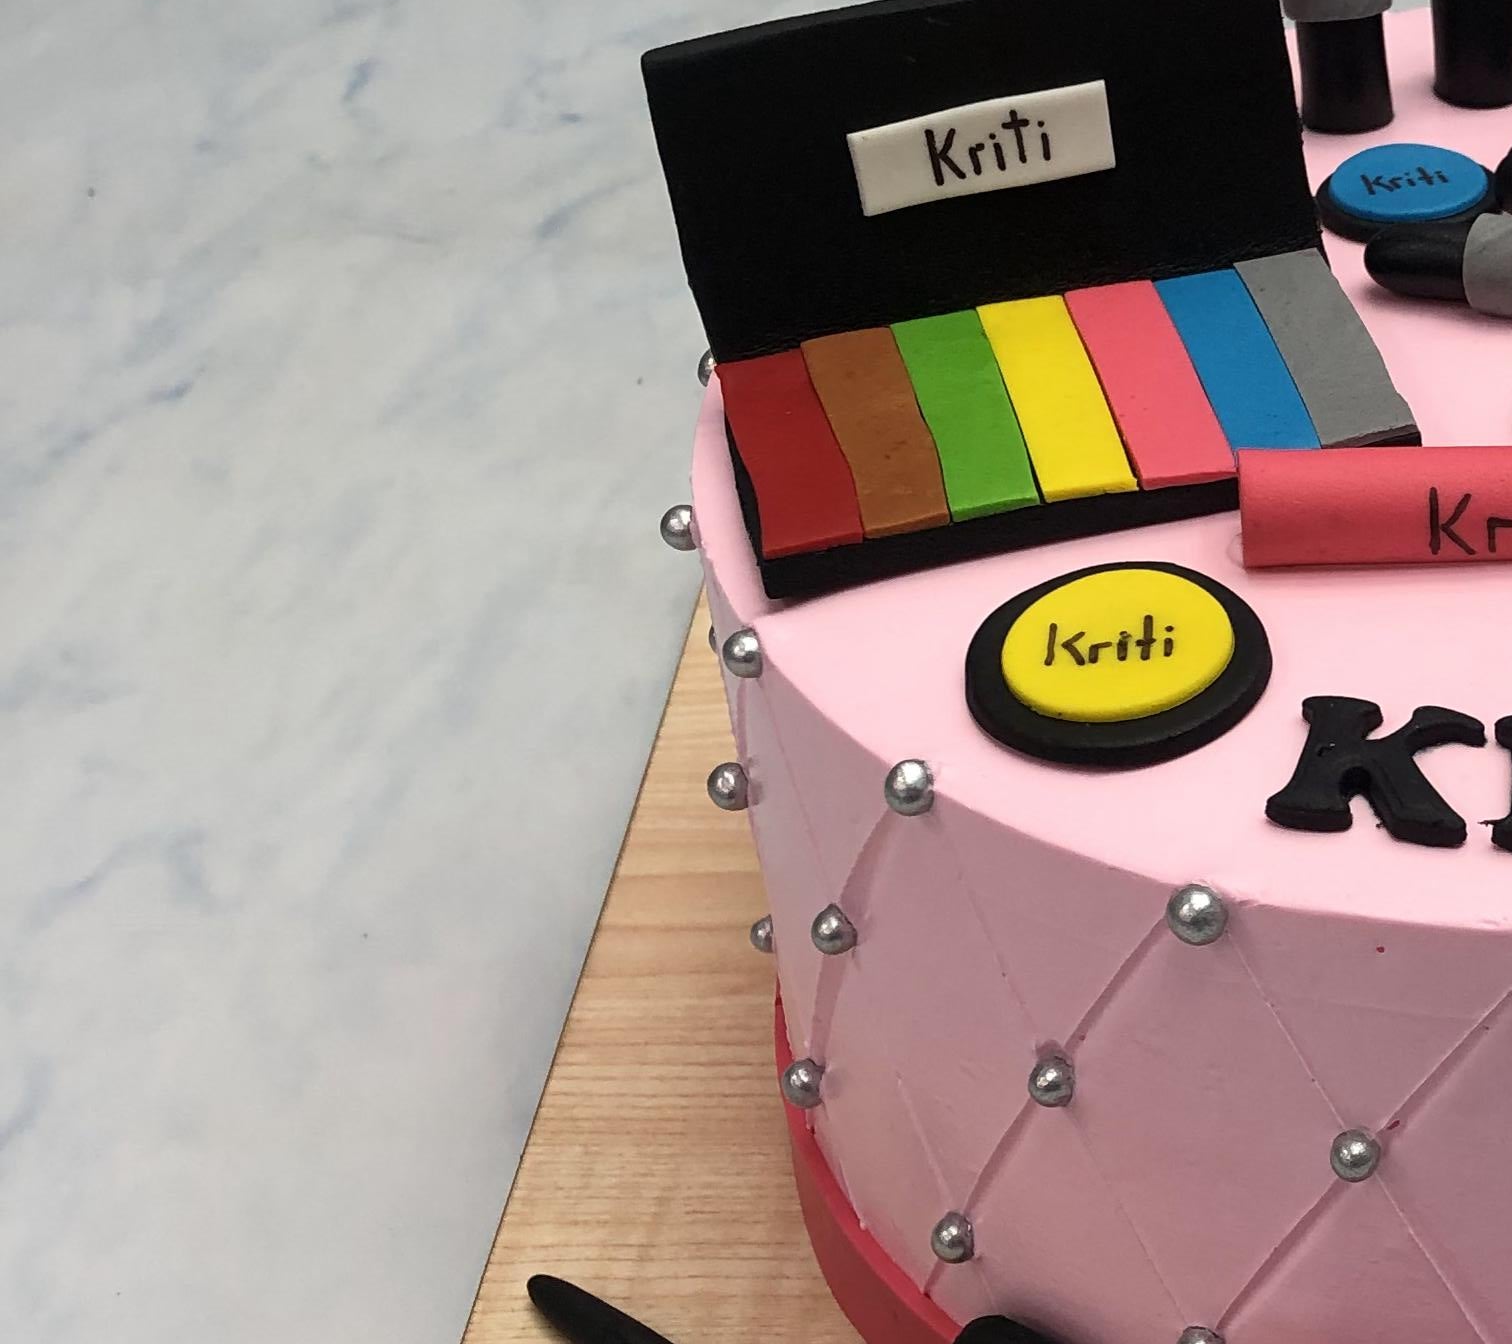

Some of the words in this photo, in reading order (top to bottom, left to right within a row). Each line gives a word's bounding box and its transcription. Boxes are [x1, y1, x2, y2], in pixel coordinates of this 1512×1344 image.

[925, 109, 1052, 187] Kriti
[1361, 167, 1451, 198] Kriti
[1044, 616, 1175, 667] Kriti
